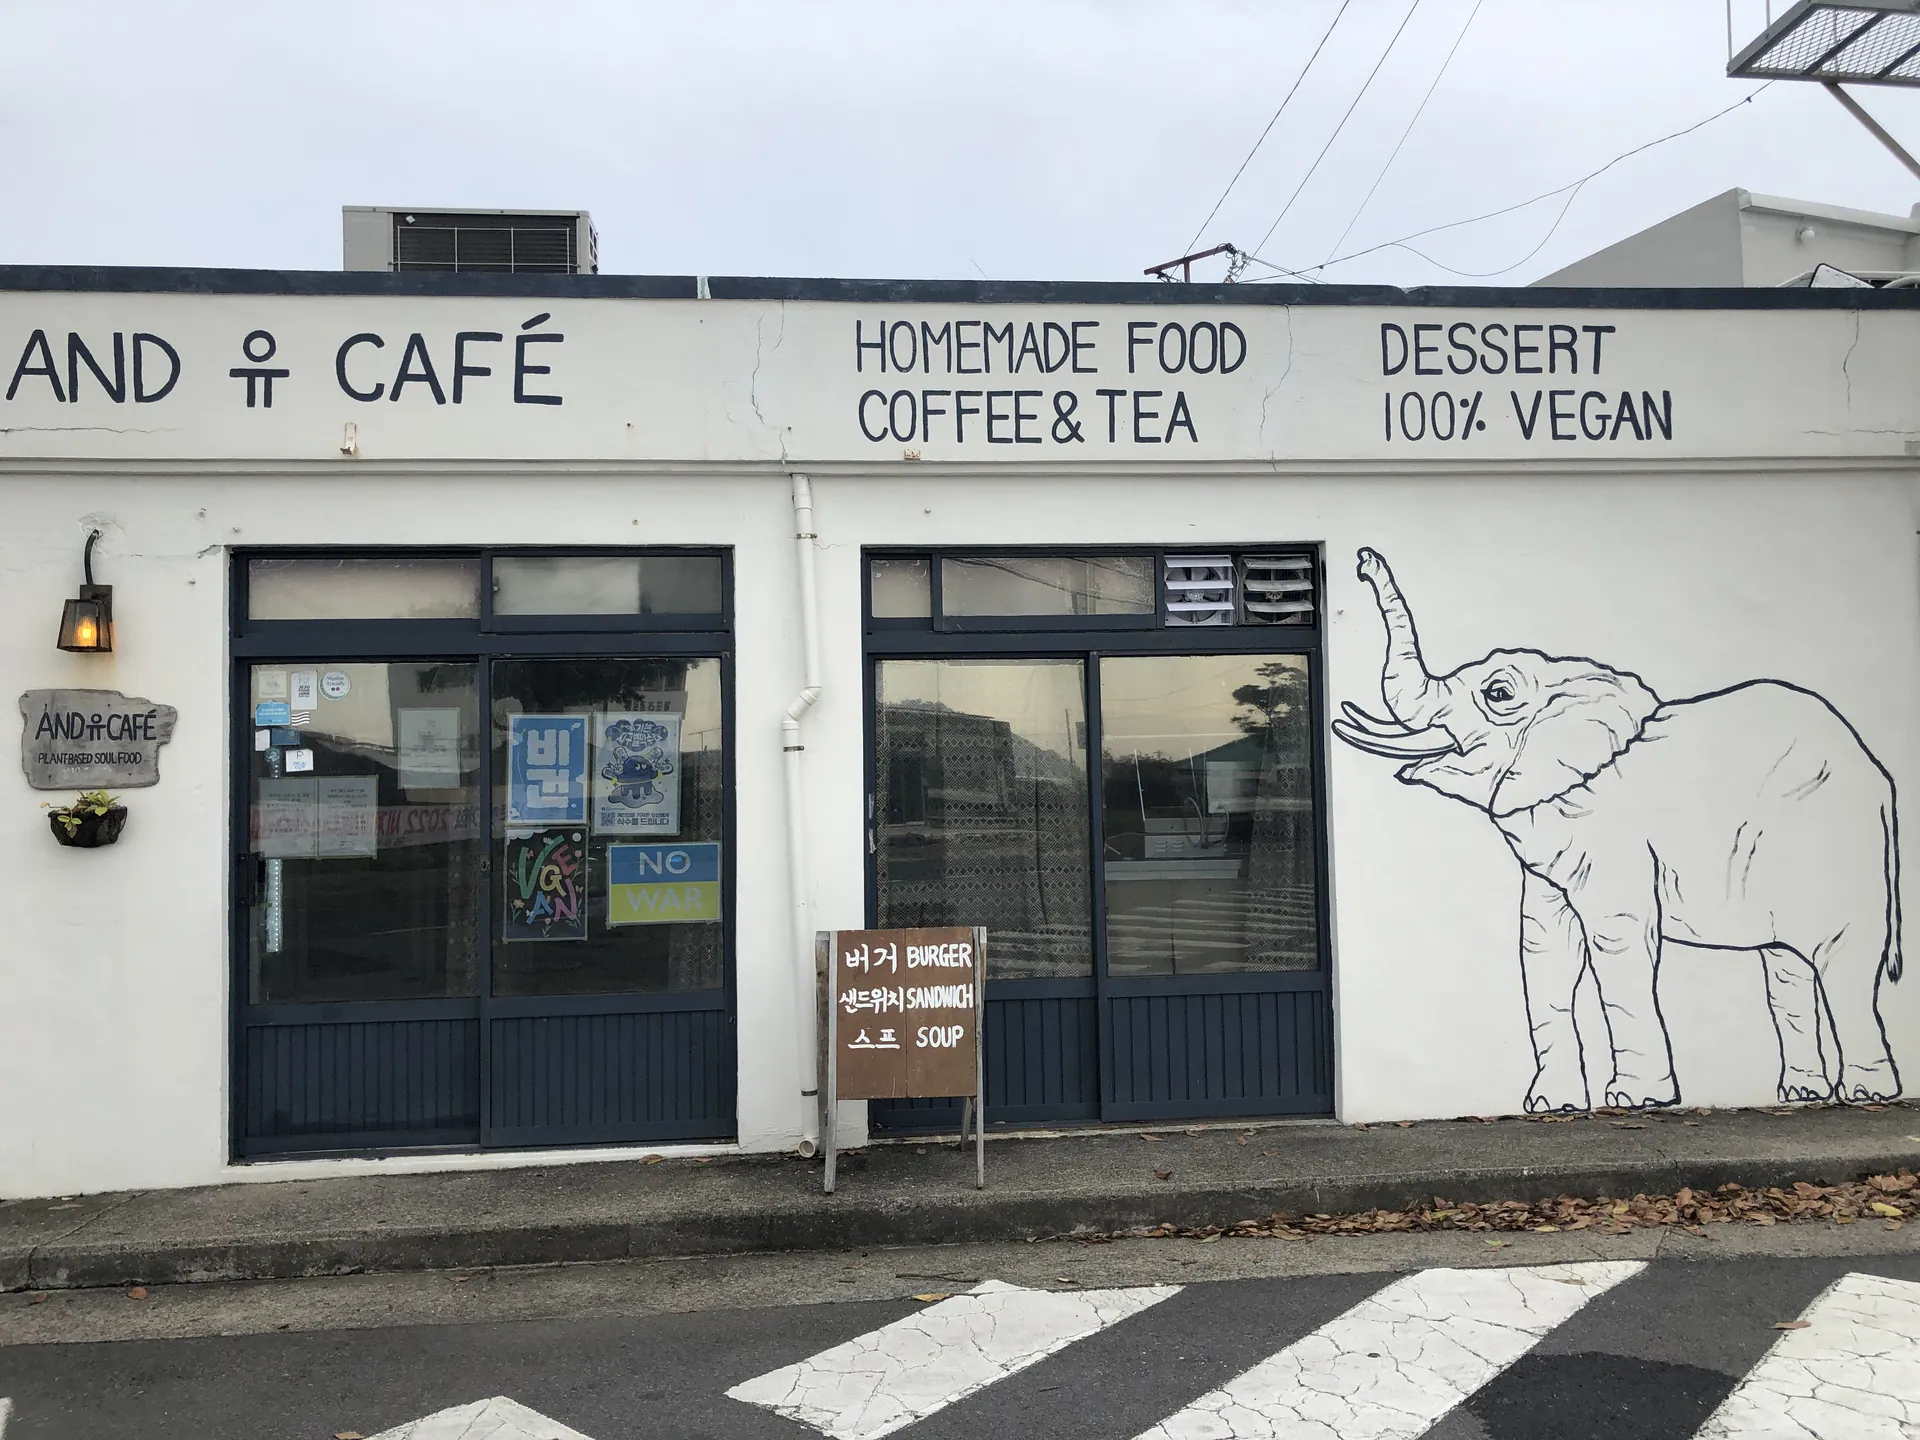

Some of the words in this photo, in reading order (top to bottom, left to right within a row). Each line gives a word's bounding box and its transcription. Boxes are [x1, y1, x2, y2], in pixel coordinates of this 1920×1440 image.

[6, 329, 181, 403] AND
[336, 312, 565, 405] CAFÉ
[857, 319, 1100, 374] HOMEMADE
[1128, 321, 1247, 375] FOOD
[1381, 322, 1616, 376] DESSERT
[1385, 391, 1486, 441] 100%
[1510, 390, 1673, 441] VEGAN
[94, 752, 117, 765] SOUL
[117, 752, 142, 764] FOOD
[526, 728, 570, 809] 비건
[640, 817, 670, 826] 드립니다
[639, 850, 692, 875] NO
[518, 834, 581, 925] VEGAN
[626, 888, 703, 912] WAR
[845, 942, 898, 974] 버거
[906, 942, 973, 969] BURGER
[838, 986, 904, 1014] 샌드위치
[906, 983, 974, 1009] SANDWICH
[847, 1028, 901, 1050] 스프
[915, 1024, 965, 1048] SOUP
